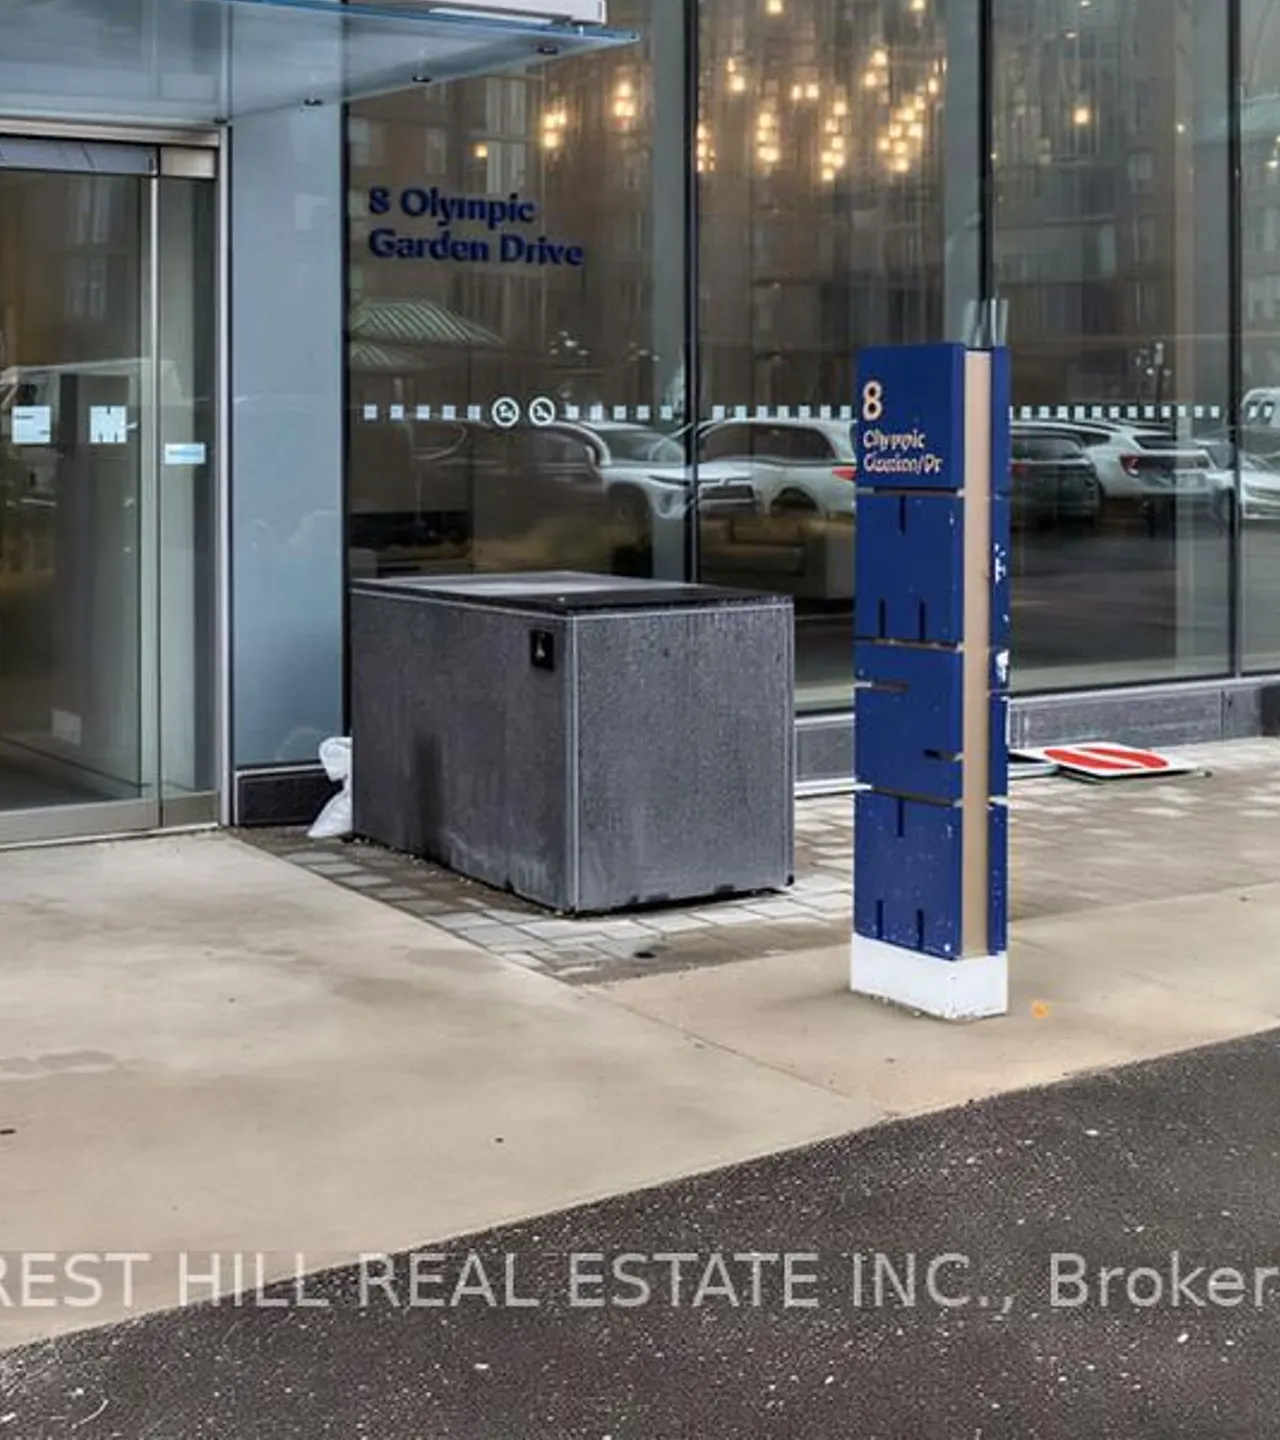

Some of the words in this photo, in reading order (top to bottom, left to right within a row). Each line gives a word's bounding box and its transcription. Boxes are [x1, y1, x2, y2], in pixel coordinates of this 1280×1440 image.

[368, 186, 391, 215] 8
[399, 186, 536, 230] Olympic
[368, 227, 490, 262] Garden
[499, 232, 585, 266] Drive
[863, 380, 882, 421] 8
